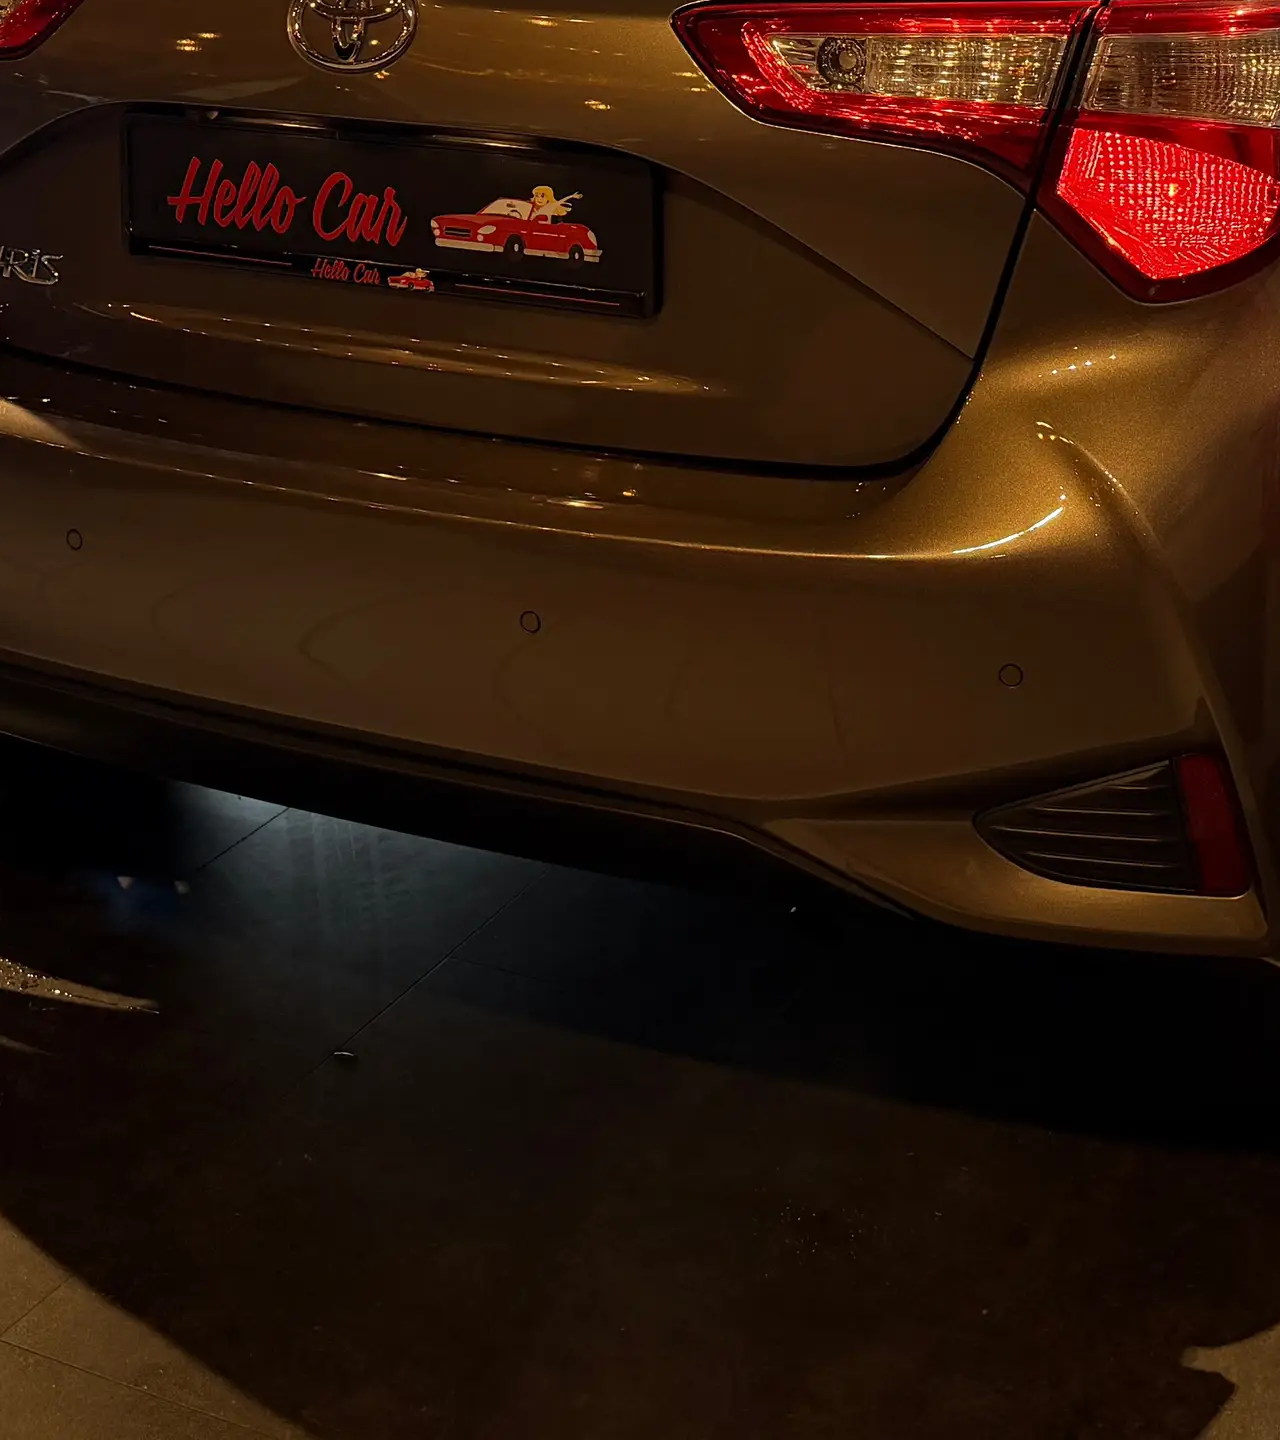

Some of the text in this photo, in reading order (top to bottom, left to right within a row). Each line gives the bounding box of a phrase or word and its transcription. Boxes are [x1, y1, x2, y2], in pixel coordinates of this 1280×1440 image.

[166, 155, 409, 248] Hello Car
[310, 257, 381, 286] Hello Car
